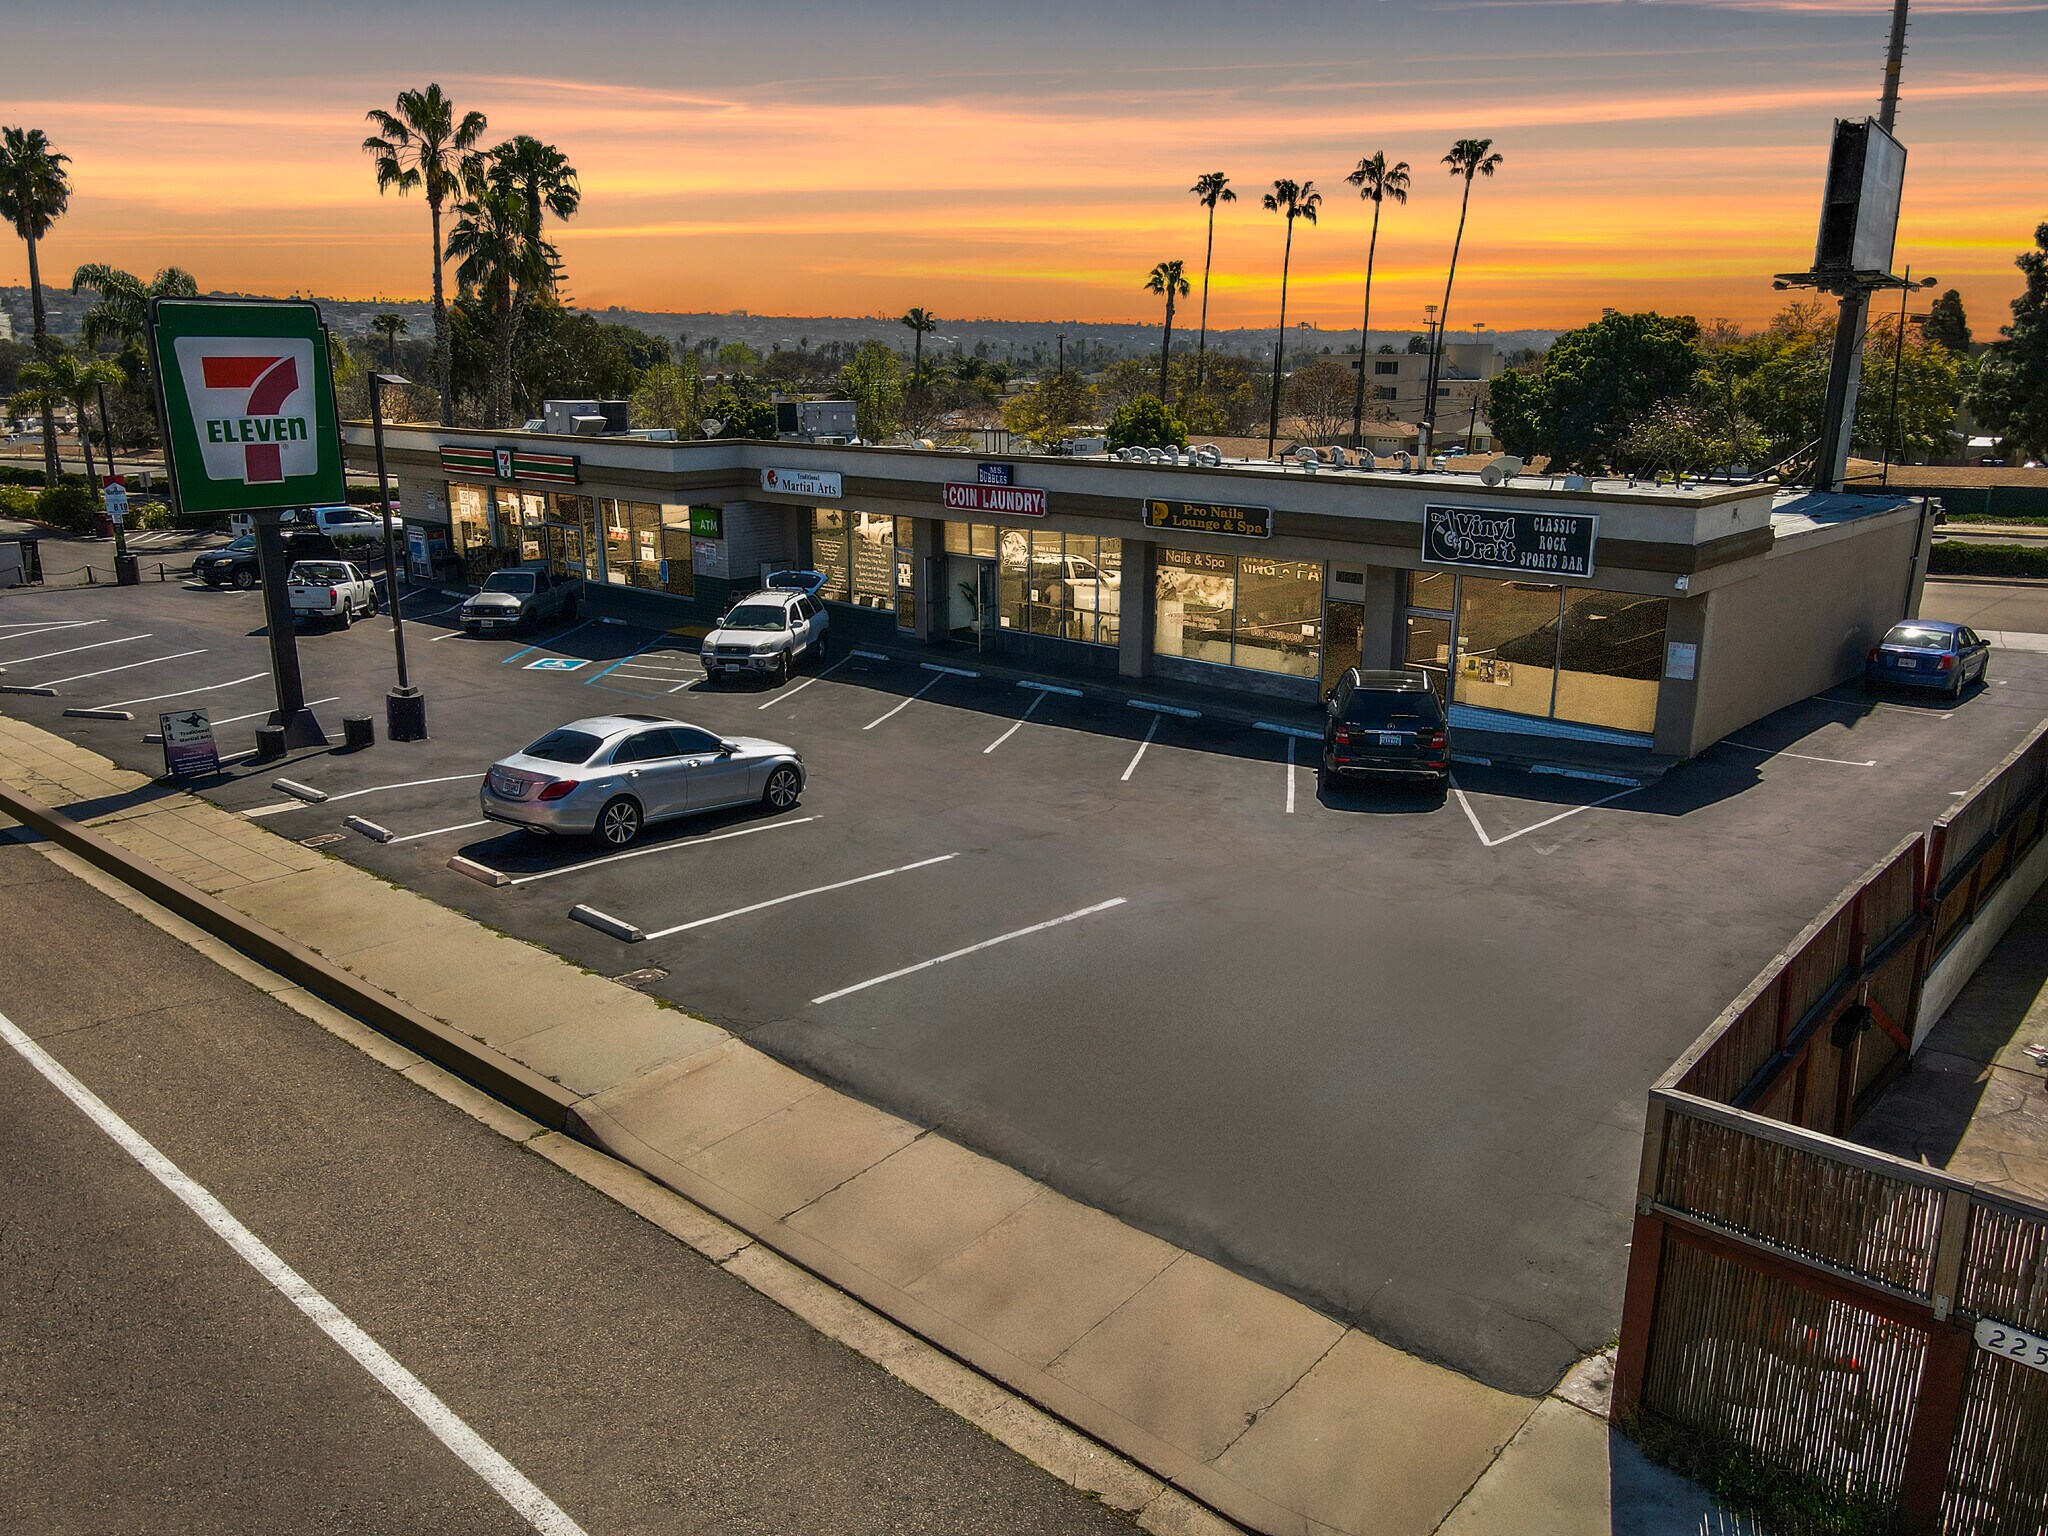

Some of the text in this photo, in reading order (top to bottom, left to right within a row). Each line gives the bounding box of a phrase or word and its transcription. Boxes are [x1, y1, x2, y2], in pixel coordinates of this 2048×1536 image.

[797, 473, 820, 481] Traditional
[979, 468, 1008, 485] BUBBLES
[989, 466, 1005, 475] MS.
[782, 479, 837, 495] Martial Arts
[949, 486, 1041, 513] COIN LAUNDRY
[1183, 504, 1244, 520] Pro Nails
[700, 519, 718, 532] ATM
[1172, 515, 1263, 535] Lounge & Spa
[1456, 513, 1516, 542] Vinyl
[1533, 517, 1577, 534] CLASSIC
[1456, 537, 1517, 563] Draft
[1539, 535, 1567, 552] ROCK
[1165, 549, 1225, 569] Nails & Spa
[1519, 551, 1584, 572] SPORTS BAR
[1988, 1330, 2048, 1365] 225
